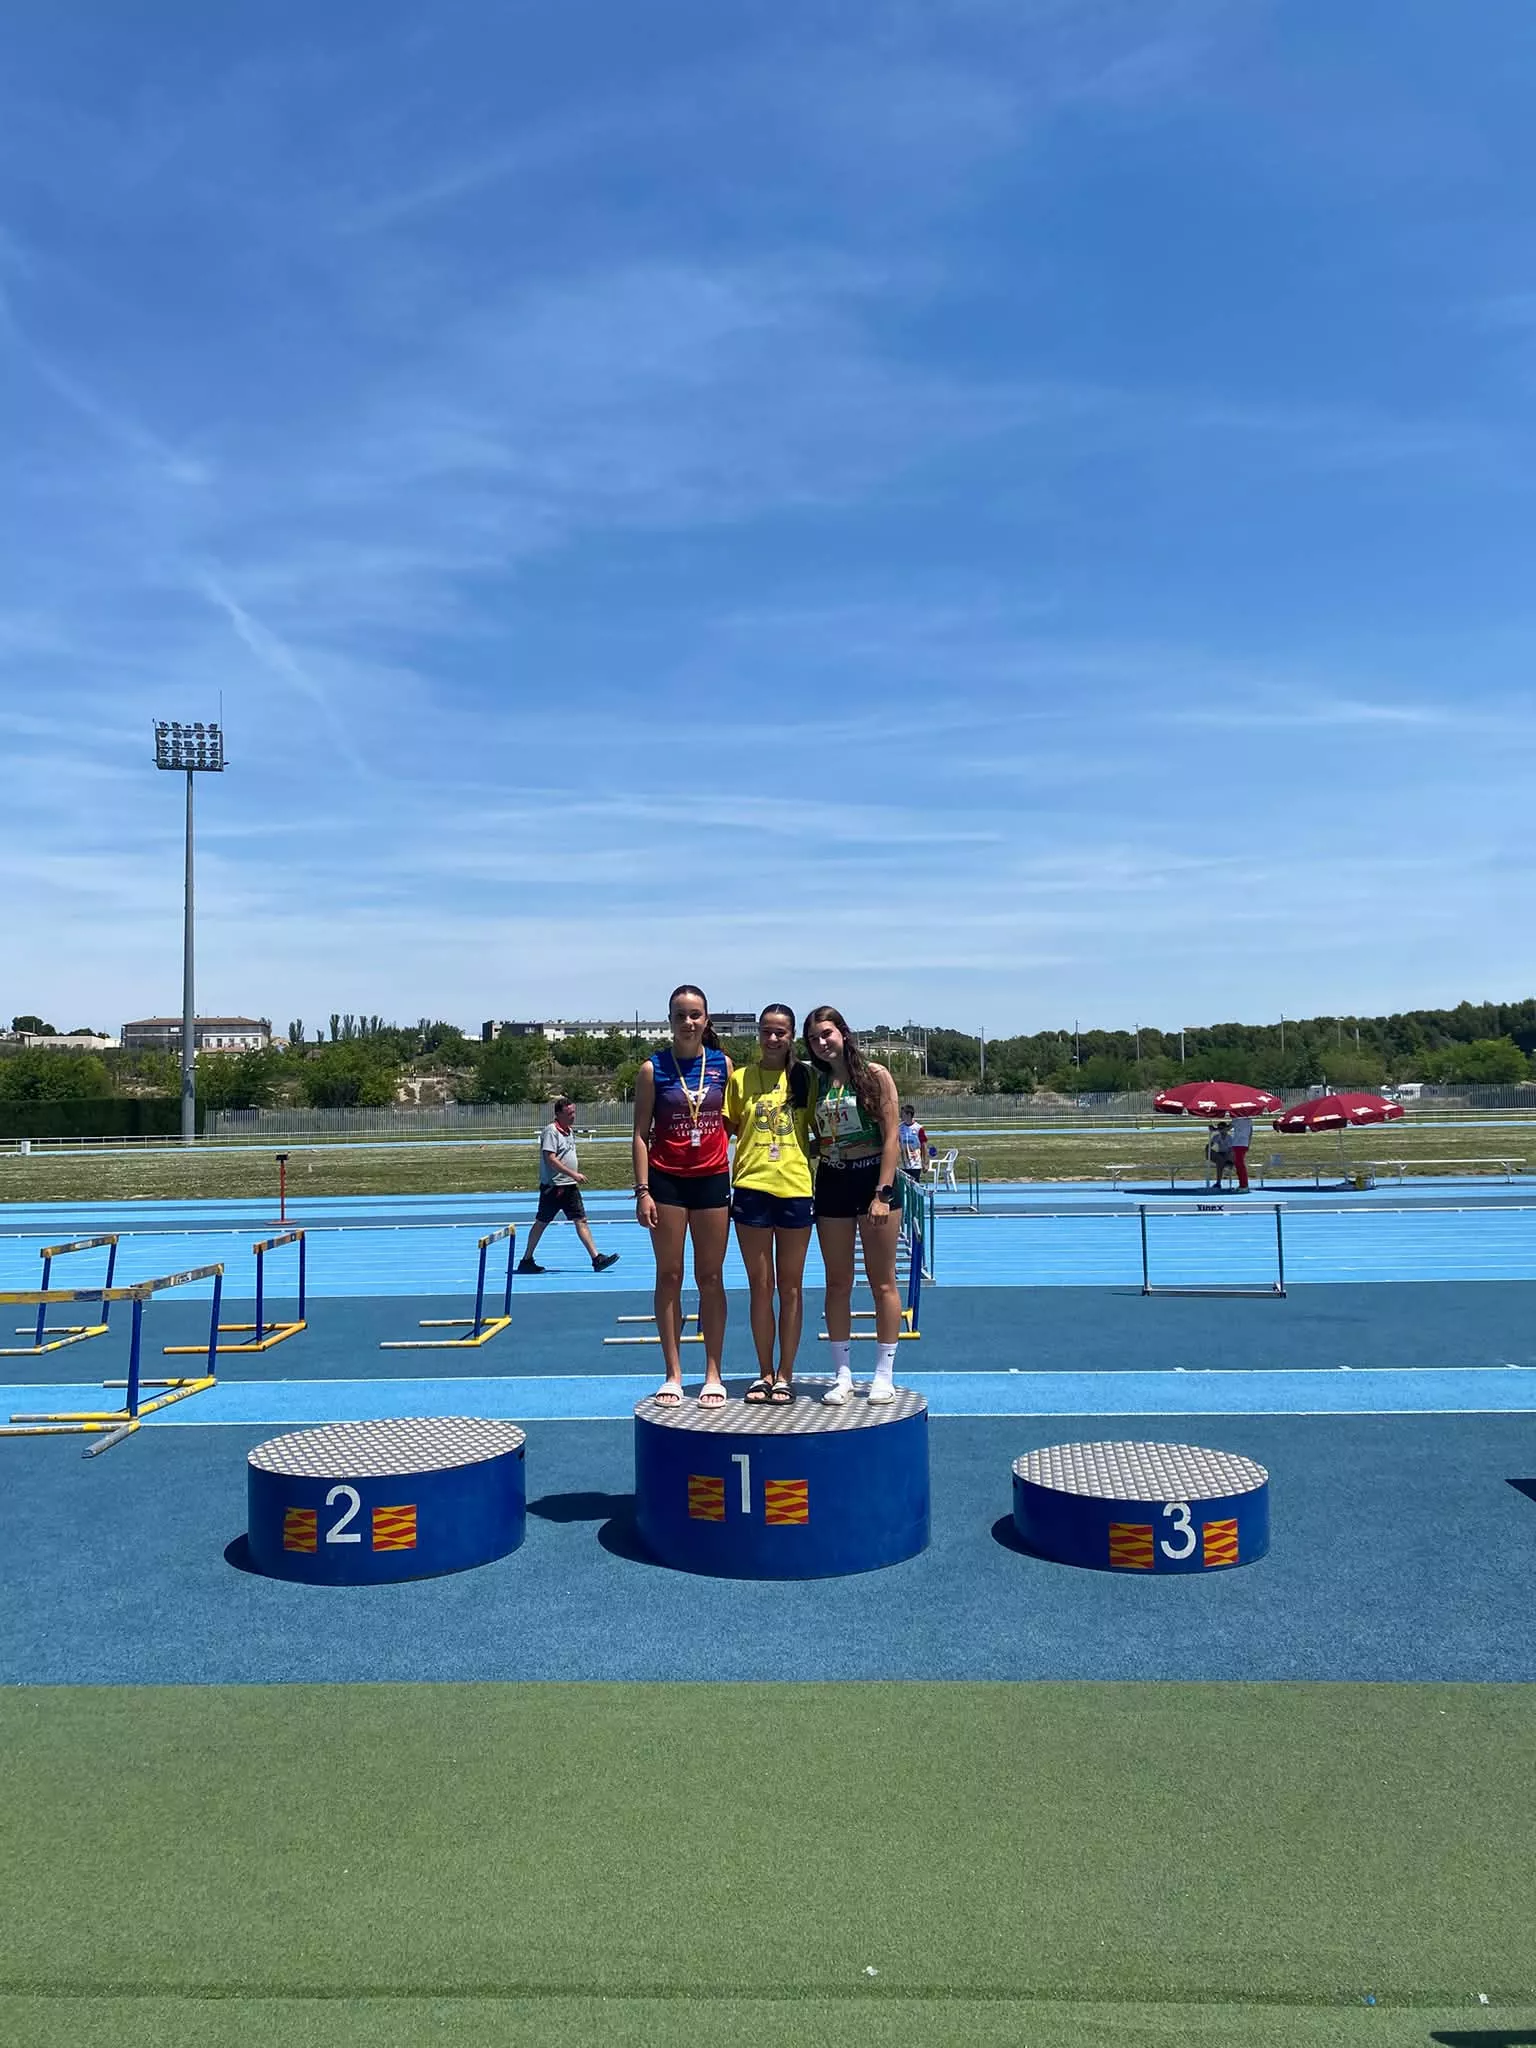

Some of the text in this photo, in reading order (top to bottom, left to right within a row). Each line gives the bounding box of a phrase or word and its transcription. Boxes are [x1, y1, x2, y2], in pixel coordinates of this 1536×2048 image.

[821, 1155, 881, 1169] PRO NIKE
[325, 1484, 361, 1543] 2
[731, 1454, 751, 1514] 1
[1160, 1501, 1197, 1560] 3
